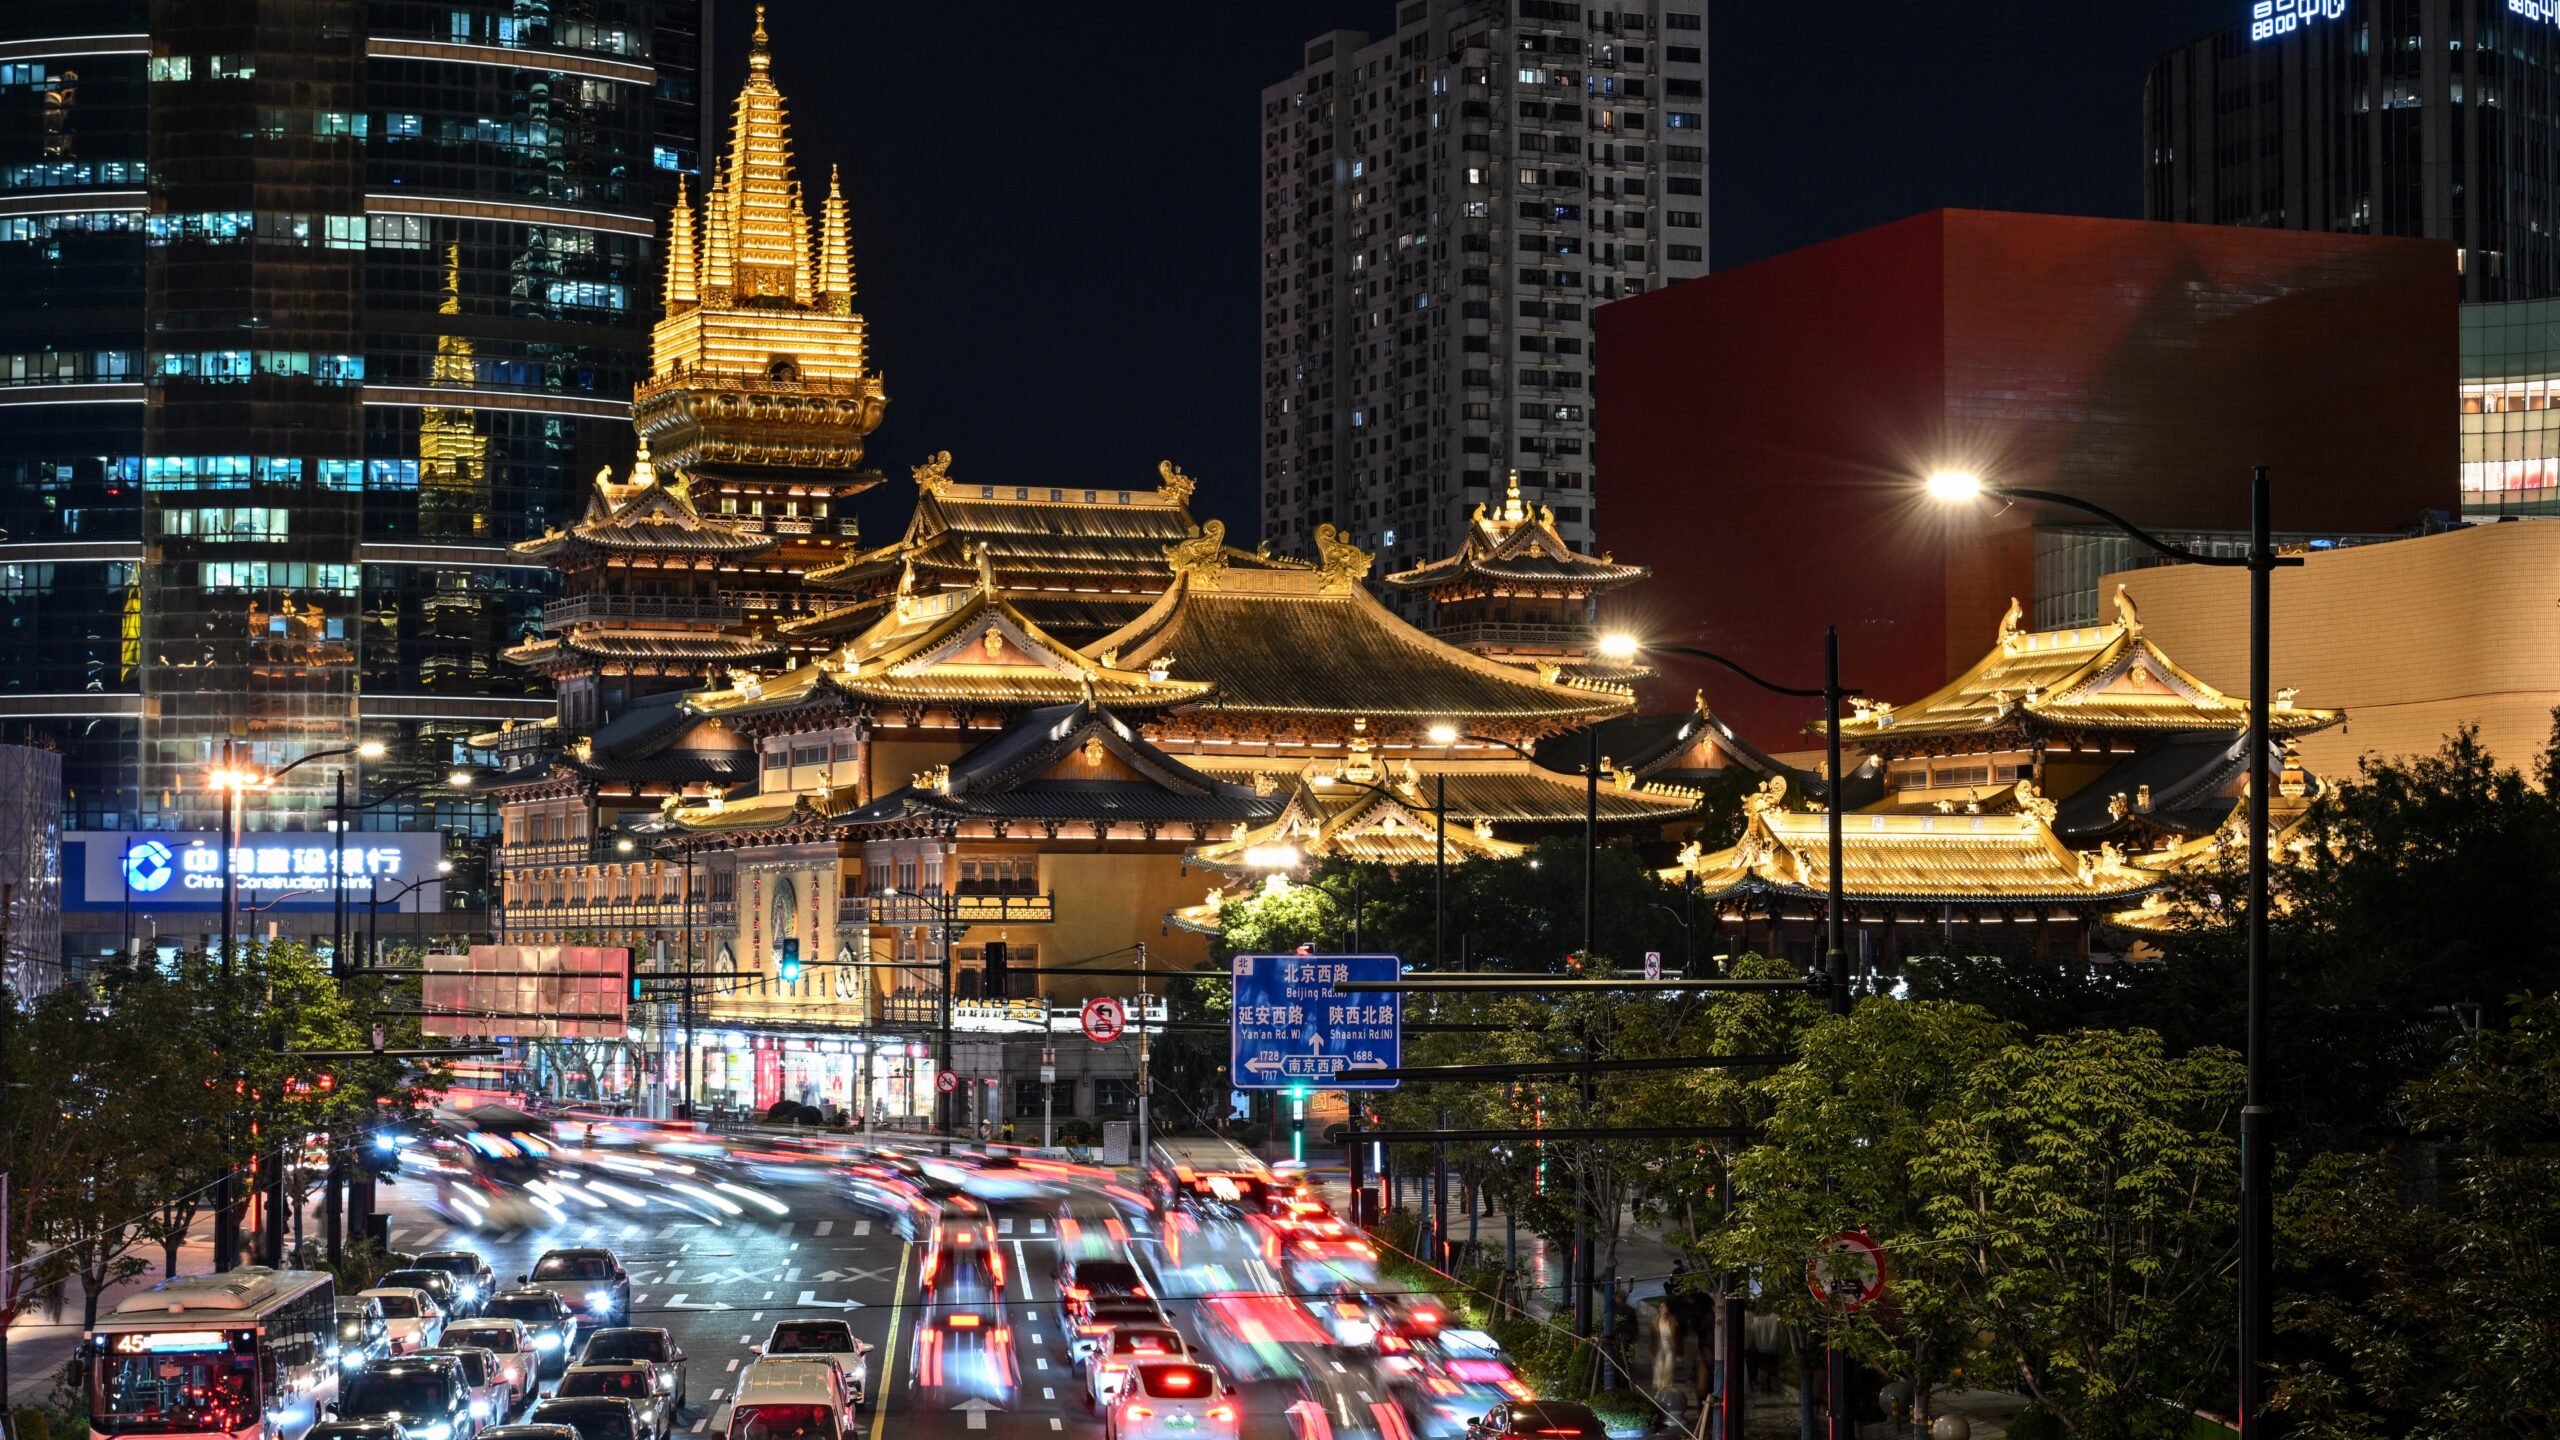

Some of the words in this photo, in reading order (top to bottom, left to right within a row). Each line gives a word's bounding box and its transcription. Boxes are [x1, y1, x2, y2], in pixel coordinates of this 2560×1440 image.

[1284, 963, 1349, 983] 北京西路
[1286, 987, 1319, 1001] Beijing
[1238, 1005, 1303, 1025] 延安西路
[1328, 1005, 1394, 1025] 陕西北路
[1241, 1028, 1273, 1040] Yan'an
[1330, 1028, 1366, 1040] Shaanxi
[1260, 1050, 1280, 1061] 1728
[1353, 1050, 1373, 1061] 1688
[1288, 1058, 1345, 1073] 南京西路
[1261, 1069, 1278, 1081] 1717
